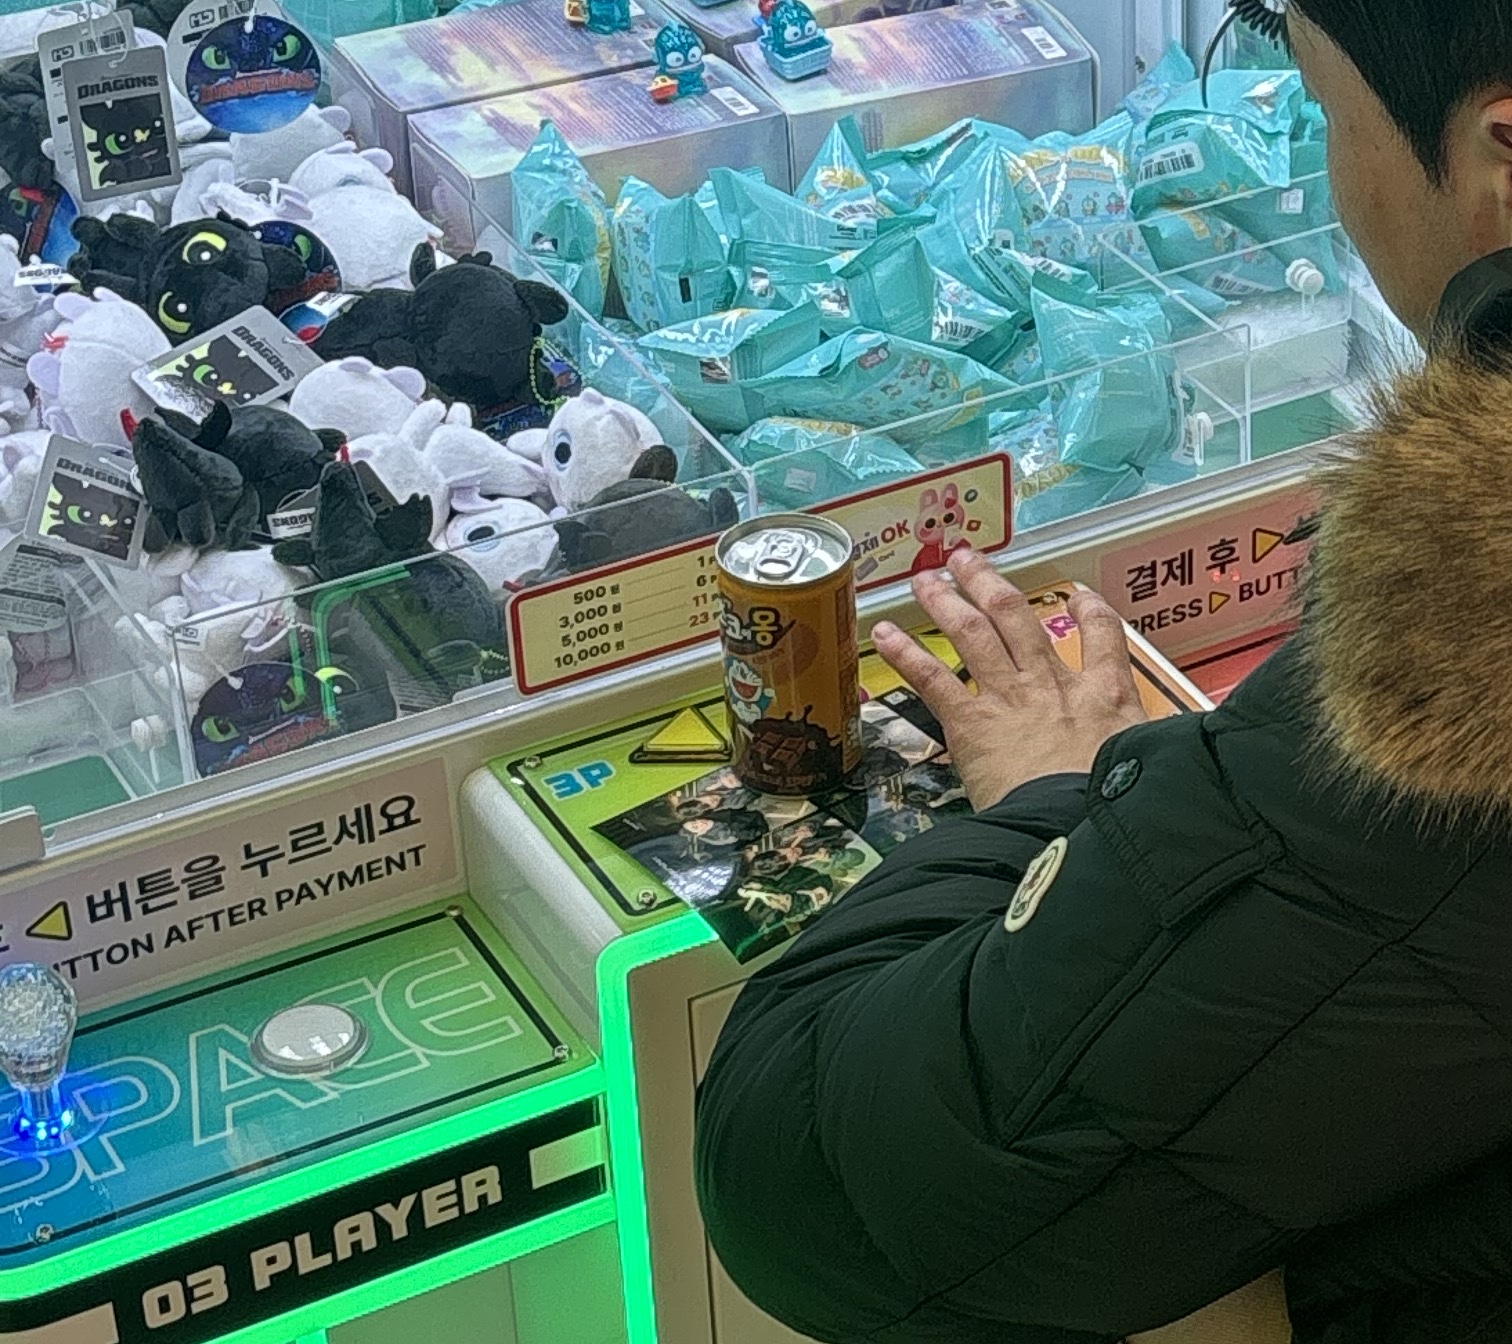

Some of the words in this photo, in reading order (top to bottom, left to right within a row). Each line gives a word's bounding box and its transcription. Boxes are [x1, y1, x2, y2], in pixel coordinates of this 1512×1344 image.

[77, 74, 160, 99] DRAGONS
[231, 325, 295, 382] DRAGONS
[56, 456, 136, 492] DRAGON
[880, 520, 911, 544] OK
[1126, 548, 1194, 604] 결제
[1205, 537, 1240, 576] 후
[1238, 567, 1300, 602] BUTT
[573, 585, 607, 606] 500
[558, 605, 608, 629] 3,000
[689, 611, 709, 628] 23
[561, 624, 610, 649] 5,000
[554, 643, 611, 668] 10,000
[544, 760, 617, 802] 3P
[86, 852, 226, 926] 버튼을
[240, 792, 421, 879] 누르세요
[163, 898, 268, 949] AFTER
[275, 844, 427, 909] PAYMENT
[142, 1263, 229, 1329] 03
[250, 1164, 502, 1291] PLAYER
